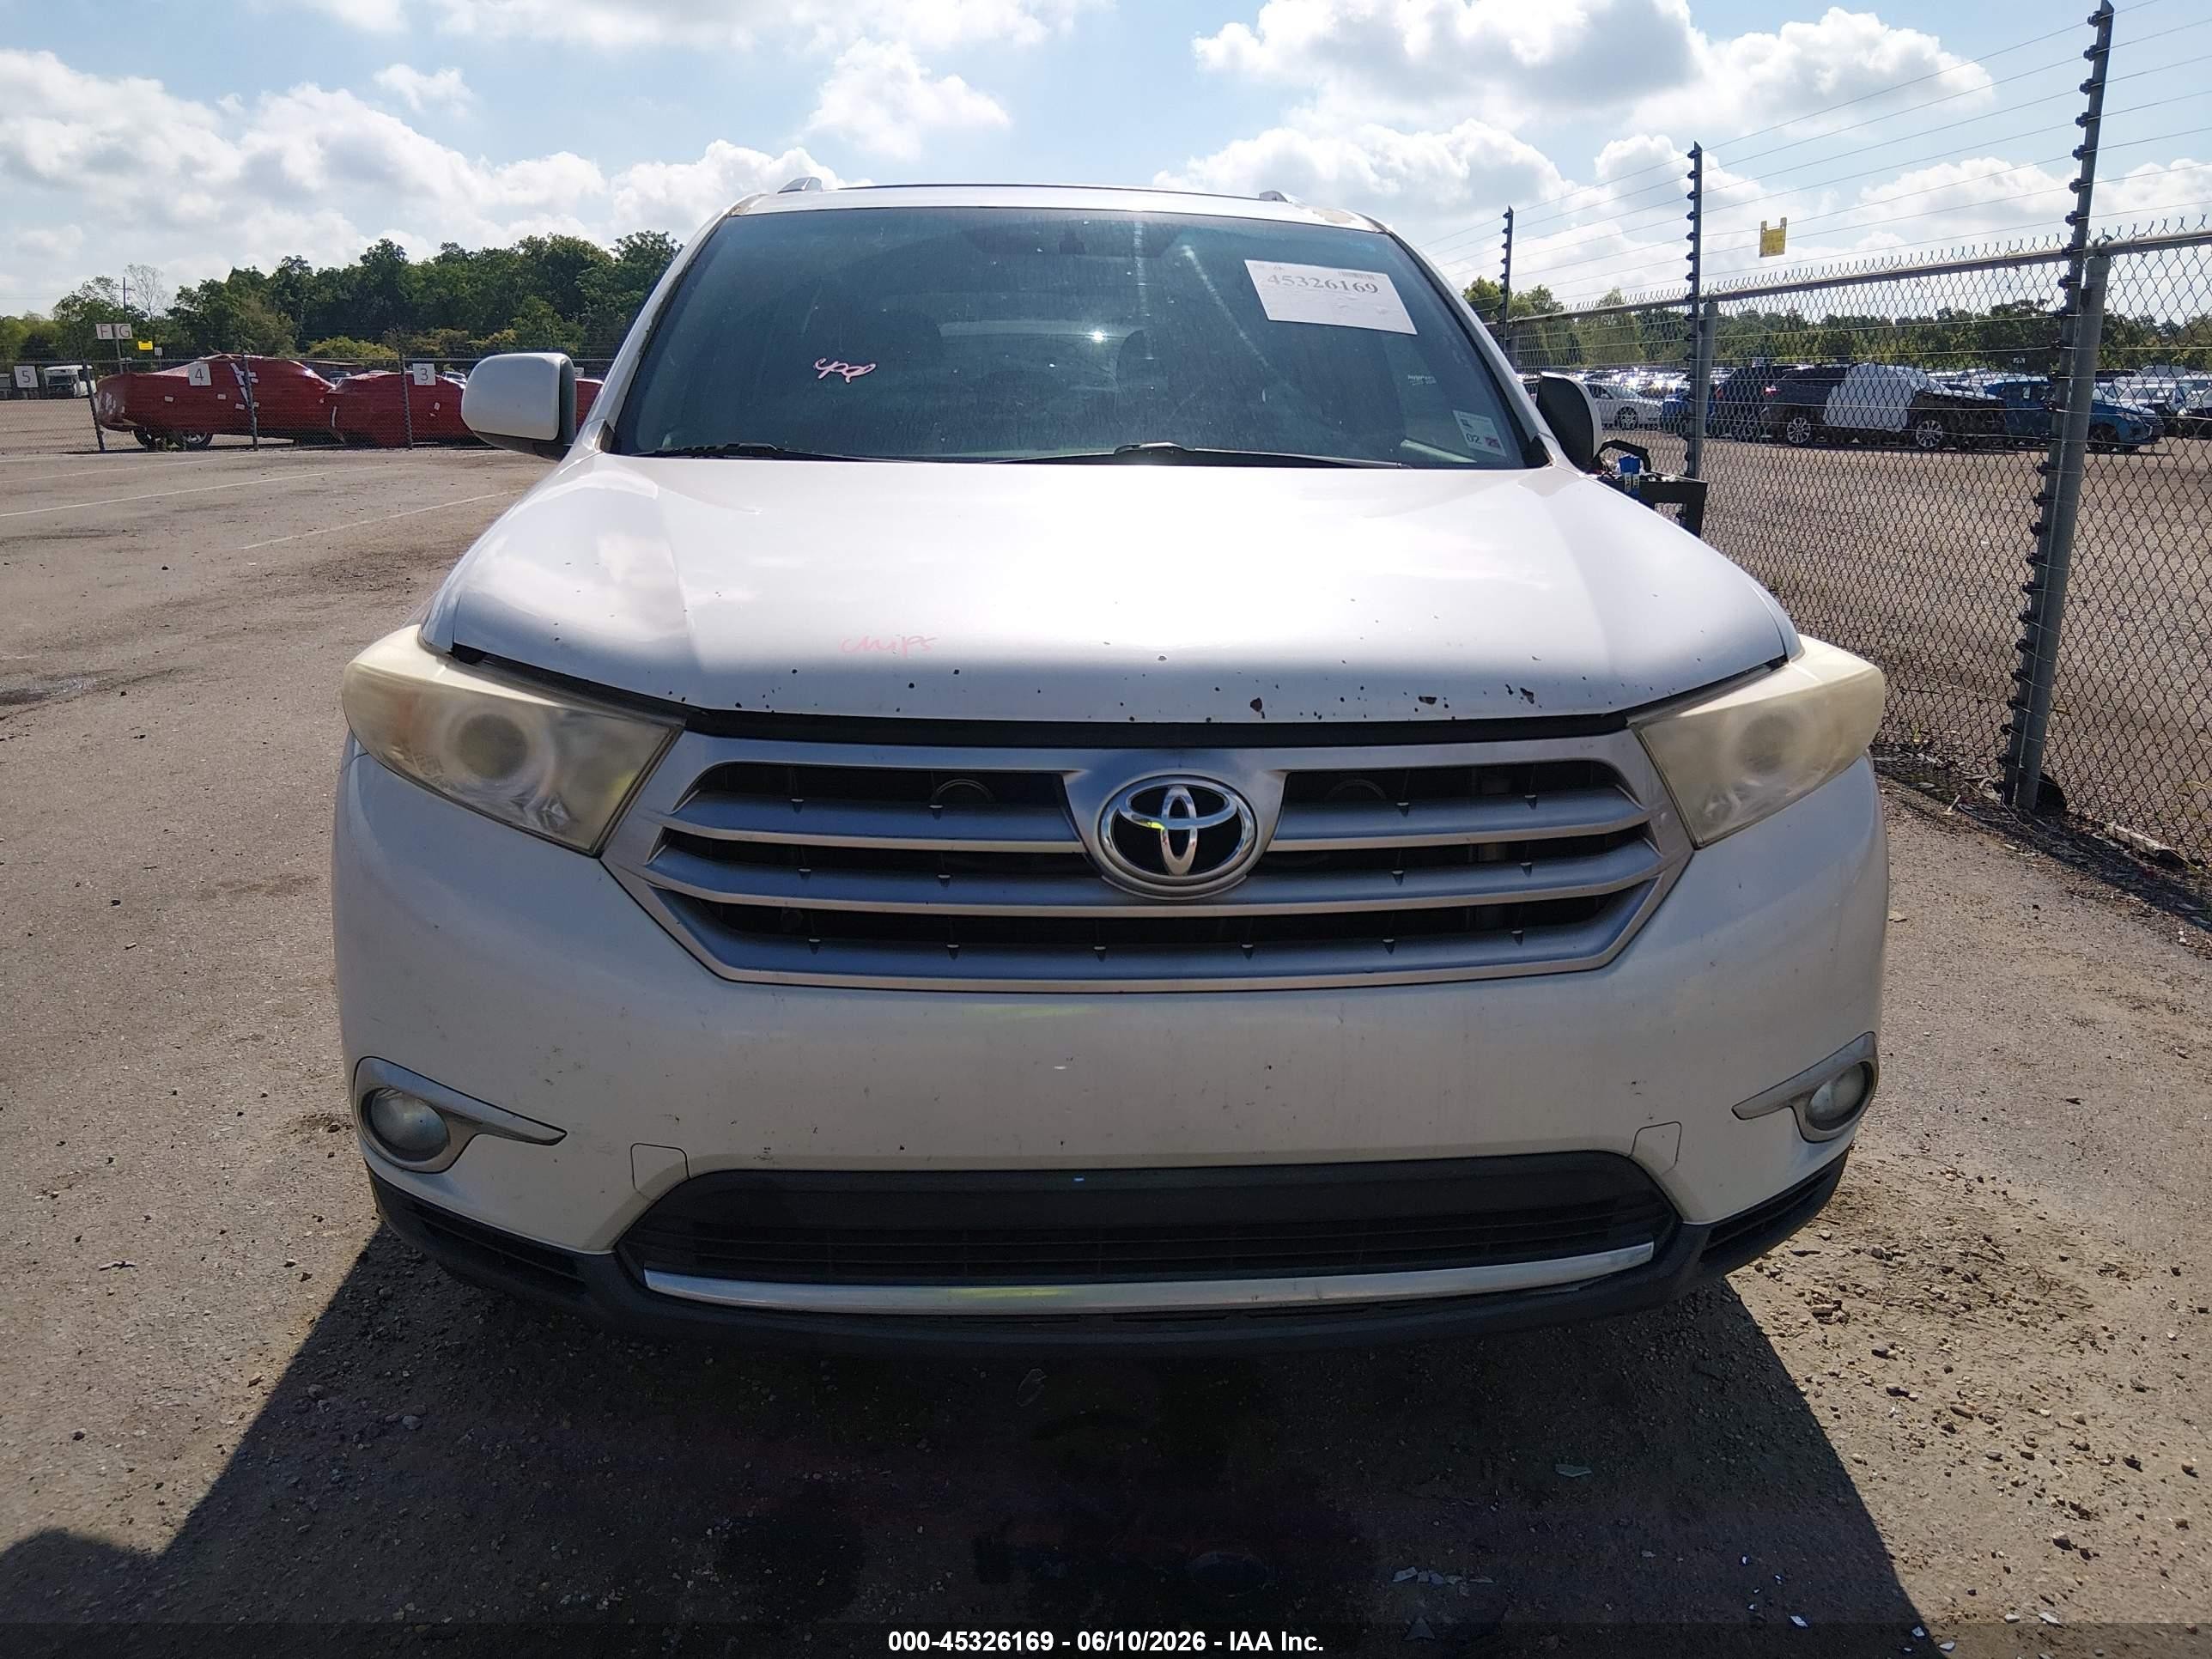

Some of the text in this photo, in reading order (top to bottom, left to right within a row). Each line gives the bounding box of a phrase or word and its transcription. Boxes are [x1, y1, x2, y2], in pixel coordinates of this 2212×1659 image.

[1267, 273, 1379, 294] 45326169
[100, 325, 109, 338] F
[119, 325, 131, 338] G
[21, 370, 31, 383] 5
[194, 368, 204, 381] 4
[420, 368, 428, 381] 3
